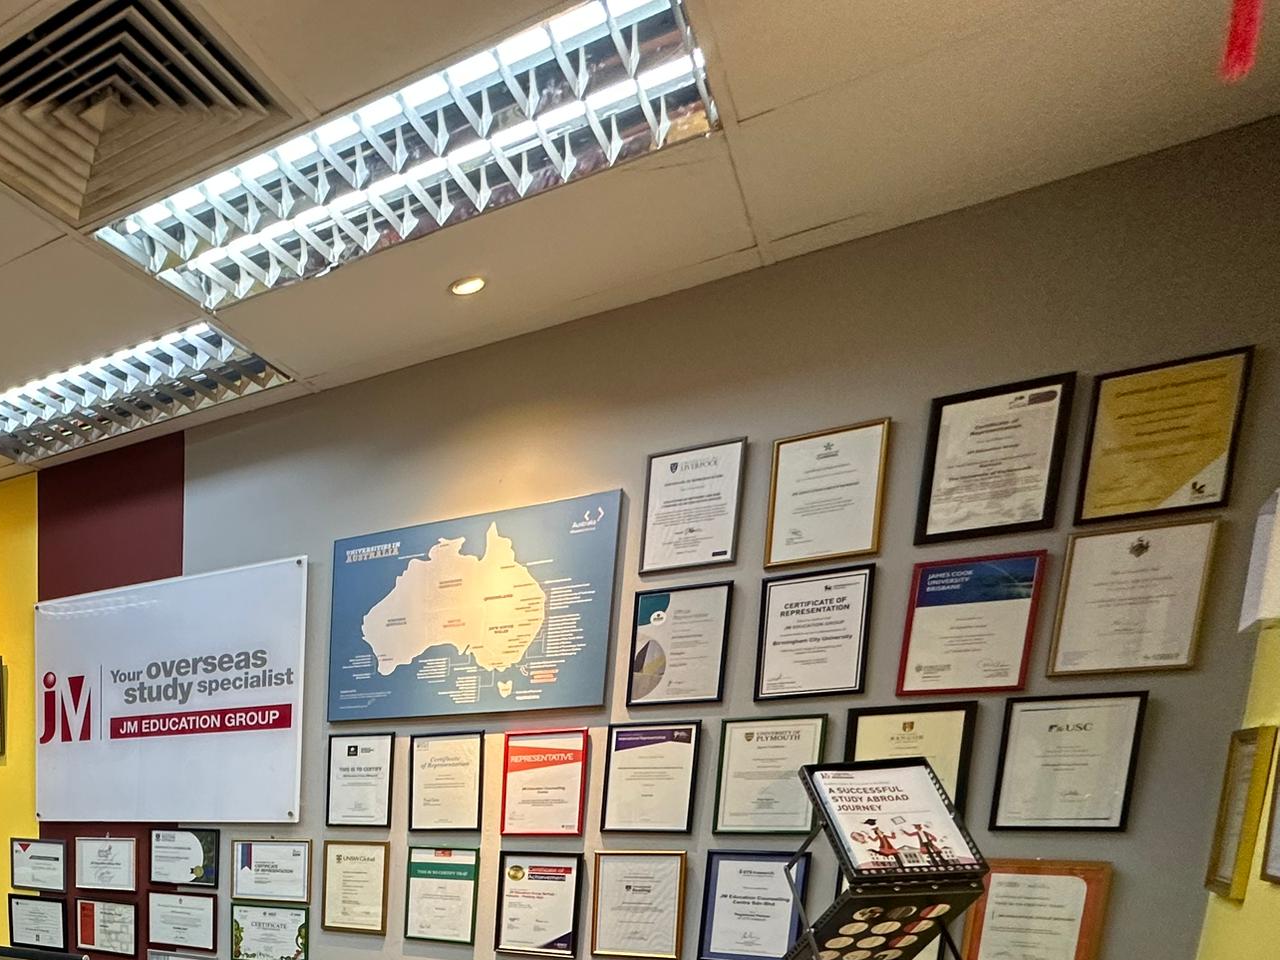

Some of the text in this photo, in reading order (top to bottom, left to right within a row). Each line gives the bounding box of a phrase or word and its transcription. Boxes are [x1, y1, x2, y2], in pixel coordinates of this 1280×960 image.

[346, 549, 400, 562] AUSTRALIA
[928, 571, 950, 580] JAMES
[928, 577, 970, 585] UNIVERSITY
[926, 584, 960, 592] BRISBANE
[784, 596, 846, 610] CERTIFICATE OF
[780, 604, 850, 617] REPRESENTATION
[110, 650, 268, 684] Your overseas
[124, 668, 294, 704] study specialist
[120, 710, 279, 734] JM EDUCATION GROUP
[1066, 722, 1093, 732] USC
[756, 734, 800, 742] PLYMOUTH
[511, 753, 574, 762] REPRESENTATIVE
[837, 786, 903, 794] SUCCESSFUL
[866, 794, 909, 802] ABROAD
[837, 804, 882, 812] JOURNEY
